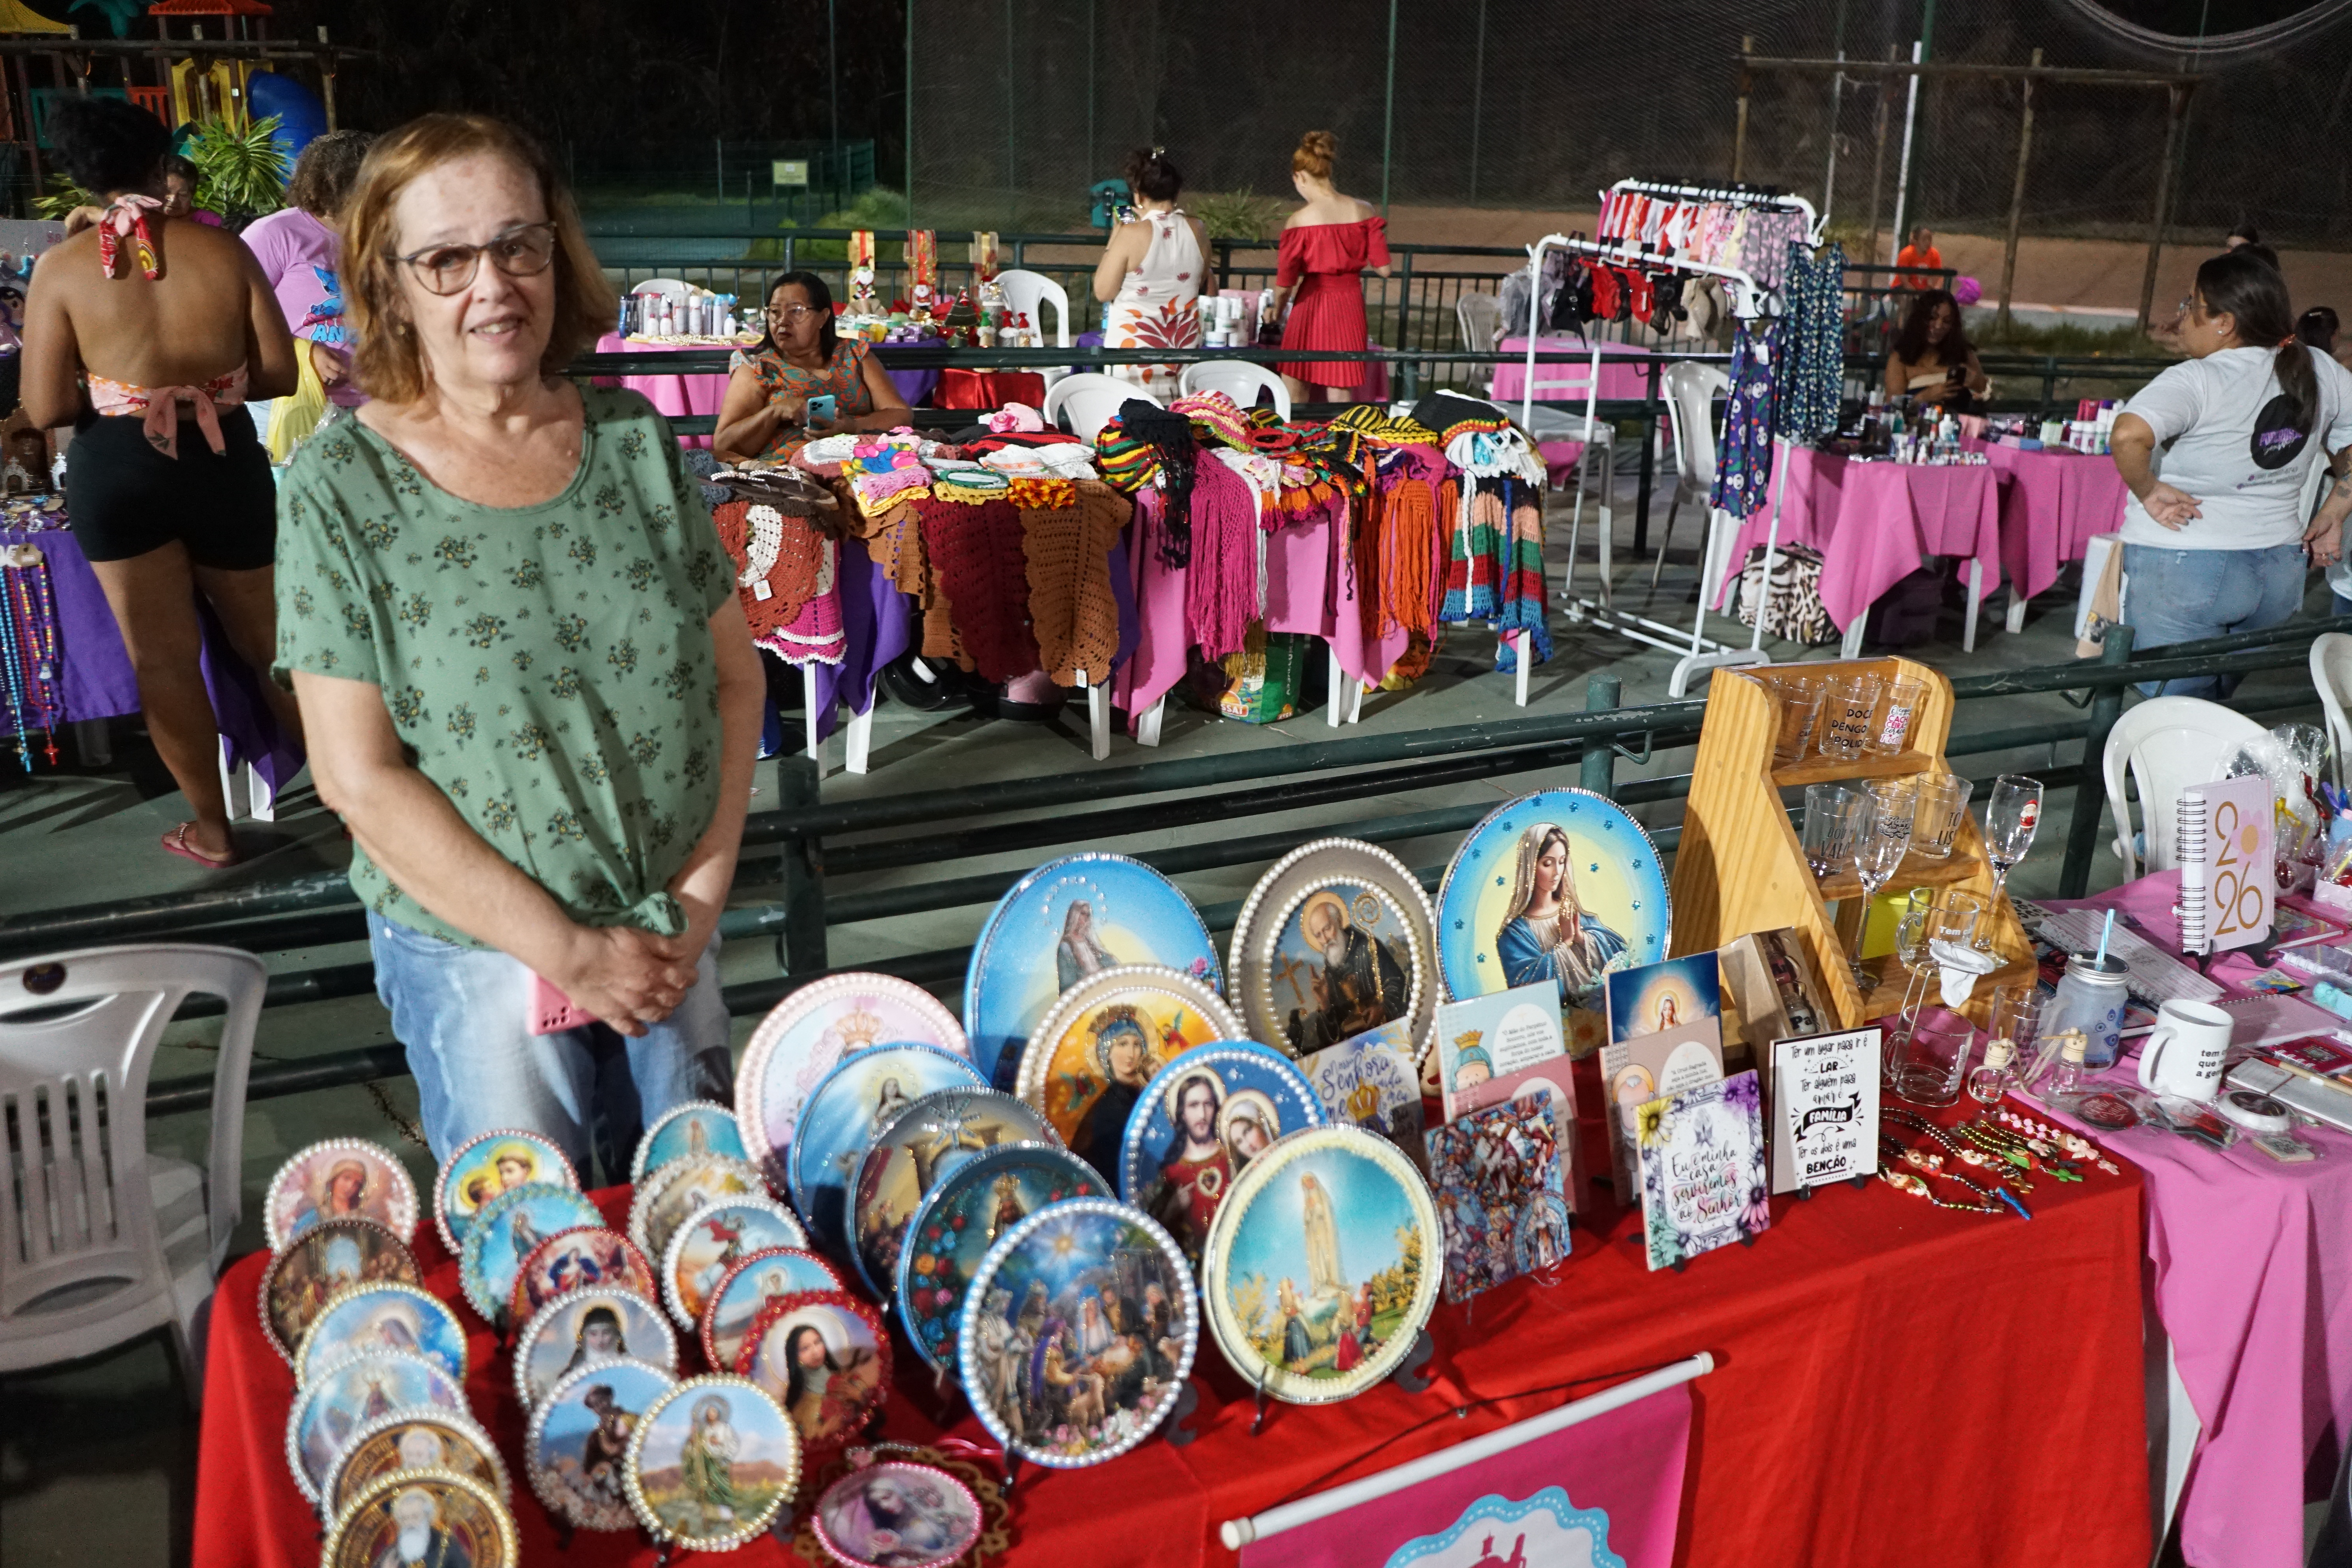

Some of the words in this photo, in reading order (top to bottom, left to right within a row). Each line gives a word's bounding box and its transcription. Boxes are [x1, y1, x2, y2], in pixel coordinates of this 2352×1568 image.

[1938, 926, 1961, 935] Tem
[1791, 1045, 1802, 1059] Ter
[1804, 1046, 1815, 1056] um
[1863, 1033, 1867, 1047] é
[1820, 1061, 1838, 1074] LAR
[1800, 1078, 1812, 1093] Ter
[1809, 1108, 1847, 1123] FAMÍLIA
[1671, 1152, 1689, 1177] Eu
[1701, 1140, 1737, 1162] minha
[1797, 1146, 1808, 1160] Ter
[1810, 1147, 1818, 1156] os
[1820, 1142, 1833, 1154] dois
[1835, 1138, 1840, 1151] é
[1842, 1138, 1857, 1150] uma
[1690, 1163, 1717, 1181] casa
[1806, 1154, 1846, 1174] BENÇÃO
[1671, 1172, 1737, 1211] serviremos
[1697, 1188, 1741, 1223] Senhor
